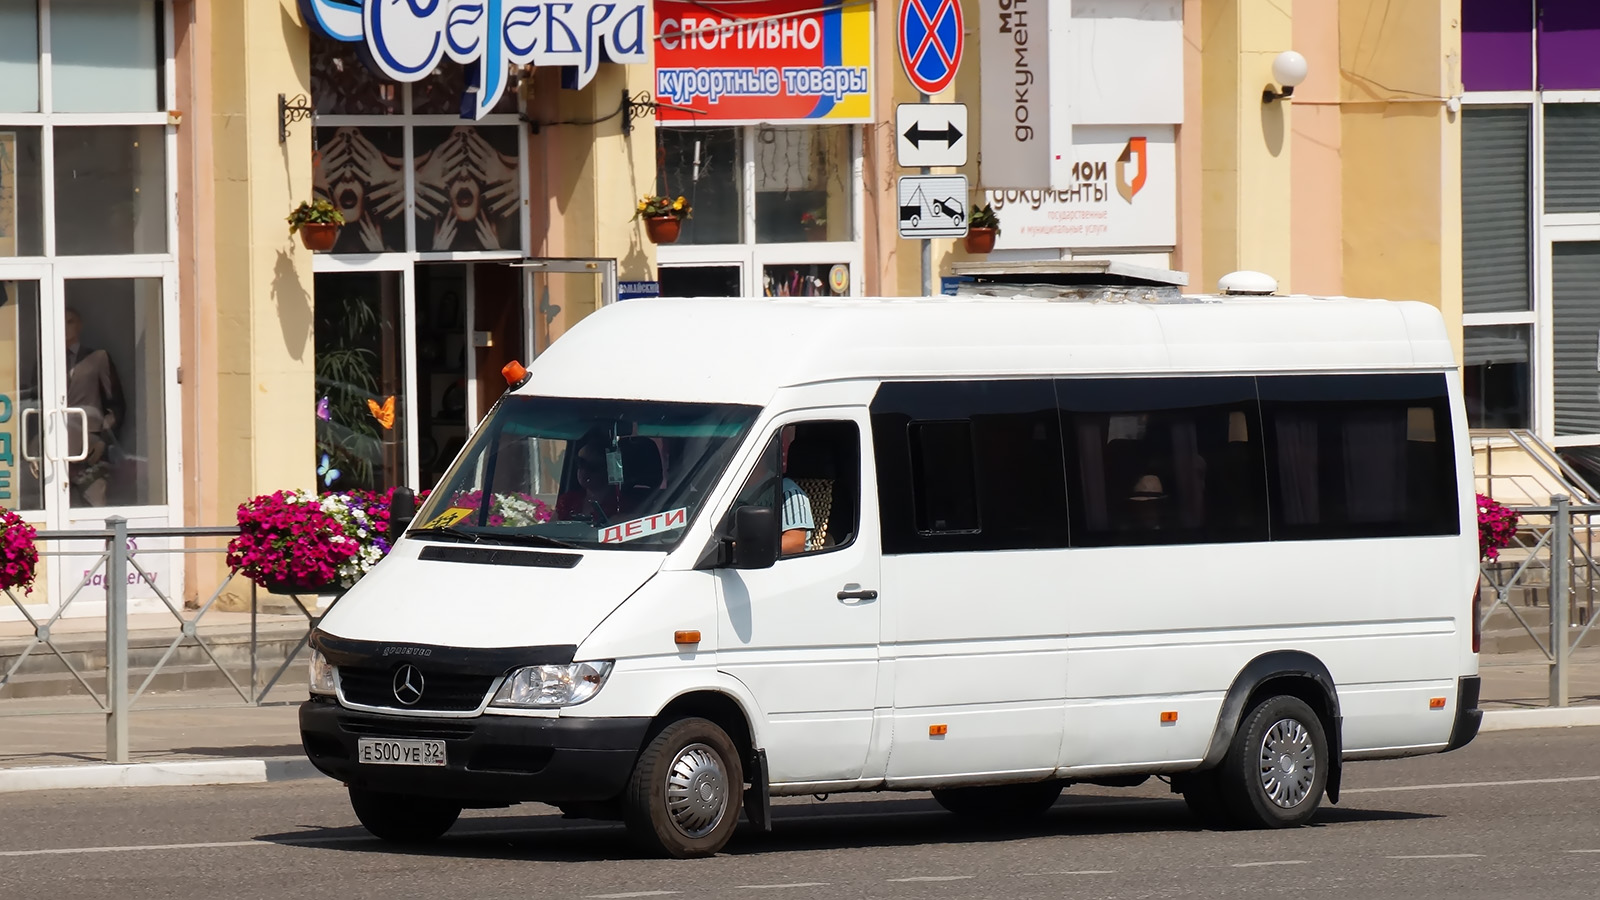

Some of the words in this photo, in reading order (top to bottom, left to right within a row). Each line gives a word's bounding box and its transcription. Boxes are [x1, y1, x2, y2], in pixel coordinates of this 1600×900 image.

[659, 17, 821, 50] СПОРТИВНО
[658, 68, 779, 103] курортные
[783, 67, 868, 102] товары
[601, 509, 684, 543] ДЕТИ
[424, 743, 440, 757] 32
